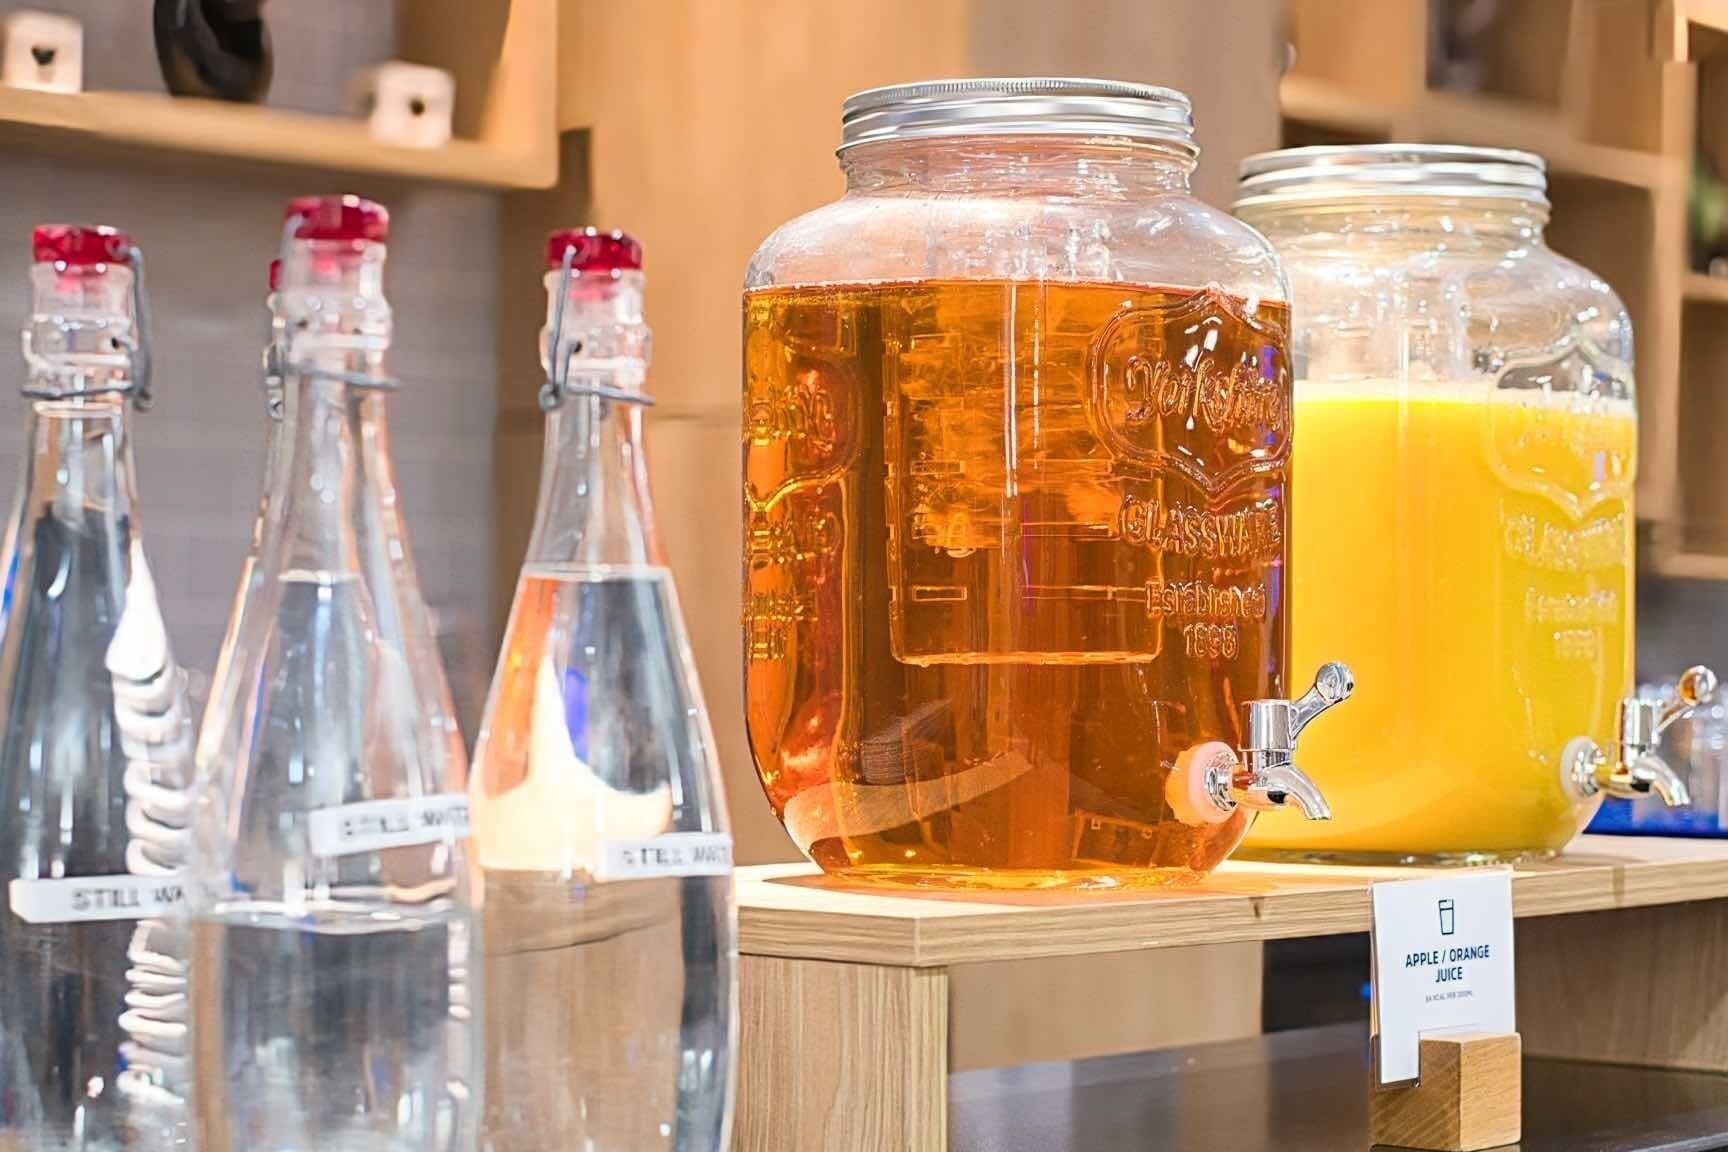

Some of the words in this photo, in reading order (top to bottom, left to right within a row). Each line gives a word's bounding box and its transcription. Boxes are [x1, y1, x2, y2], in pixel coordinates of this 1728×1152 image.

[71, 885, 141, 911] STILL
[1405, 950, 1439, 968] APPLE
[1441, 949, 1447, 964] /
[1449, 944, 1490, 963] ORANGE
[1435, 966, 1463, 983] JUICE
